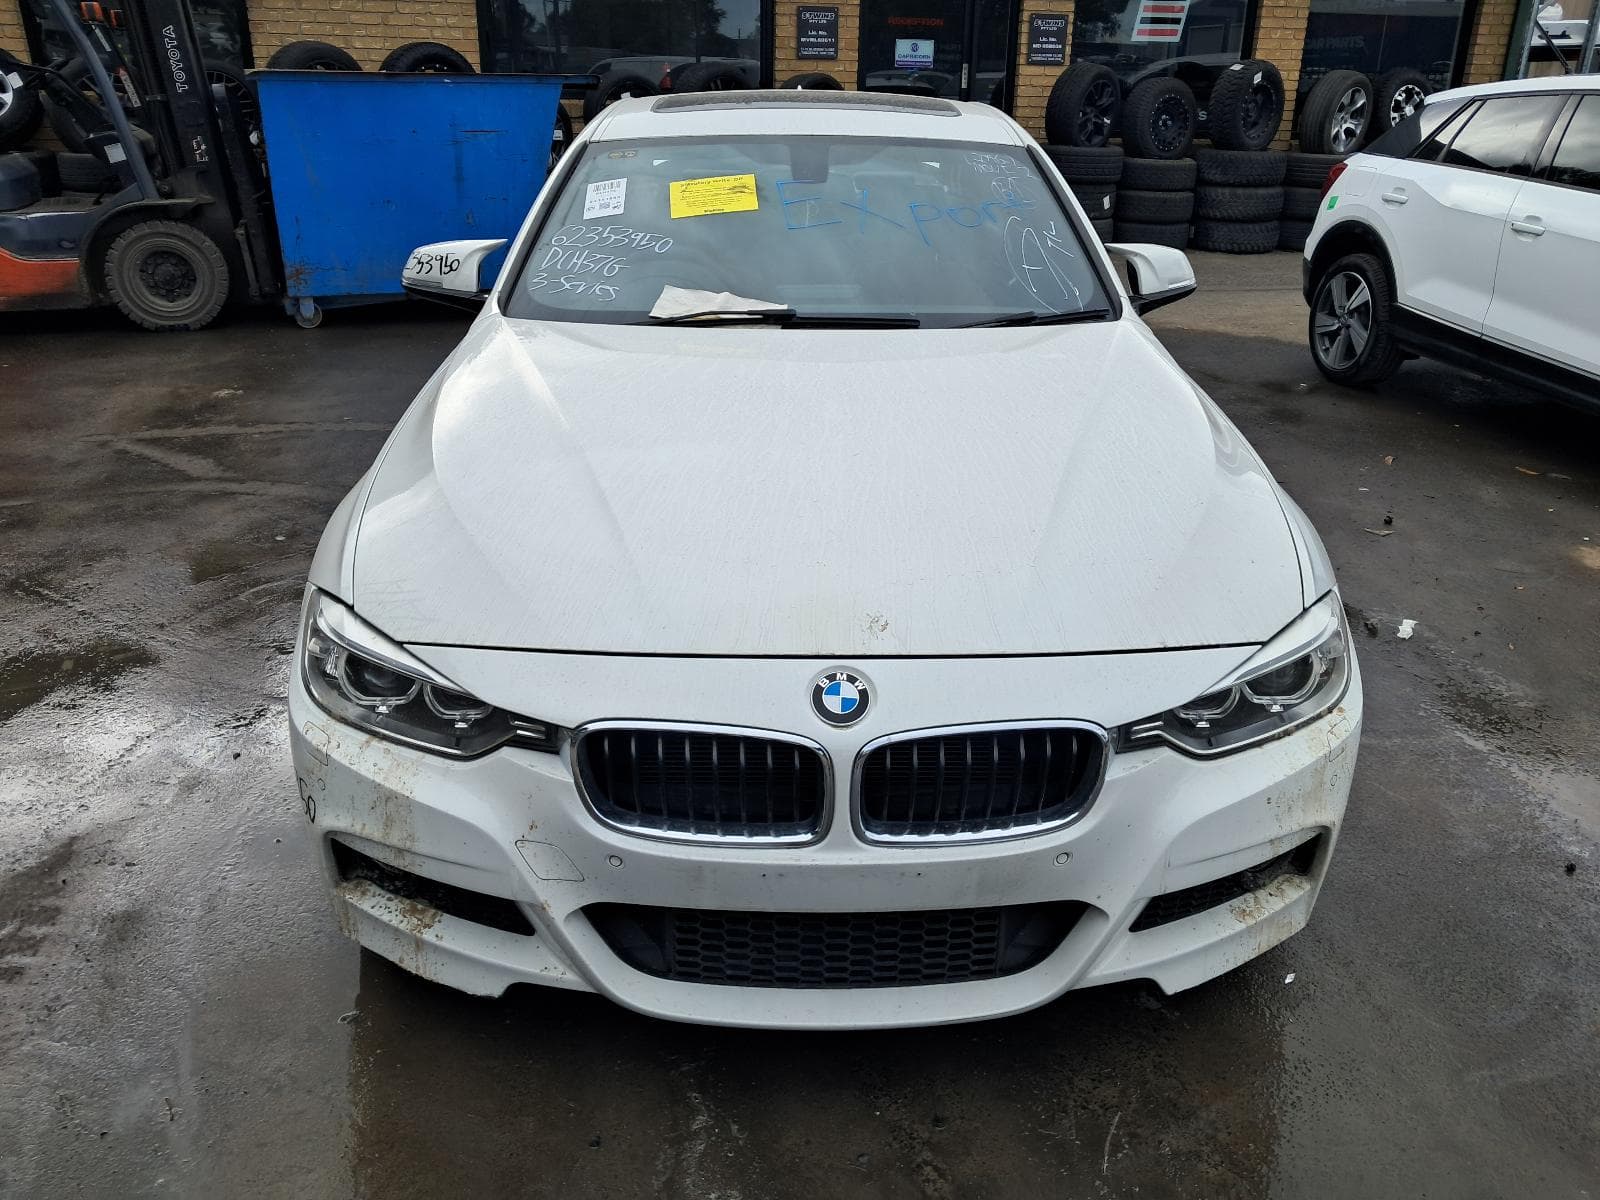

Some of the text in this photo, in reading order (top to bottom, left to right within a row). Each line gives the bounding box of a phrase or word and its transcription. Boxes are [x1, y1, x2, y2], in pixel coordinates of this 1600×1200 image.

[163, 25, 189, 92] TOYOTA
[552, 224, 673, 254] 62353950
[817, 671, 867, 691] BMW
